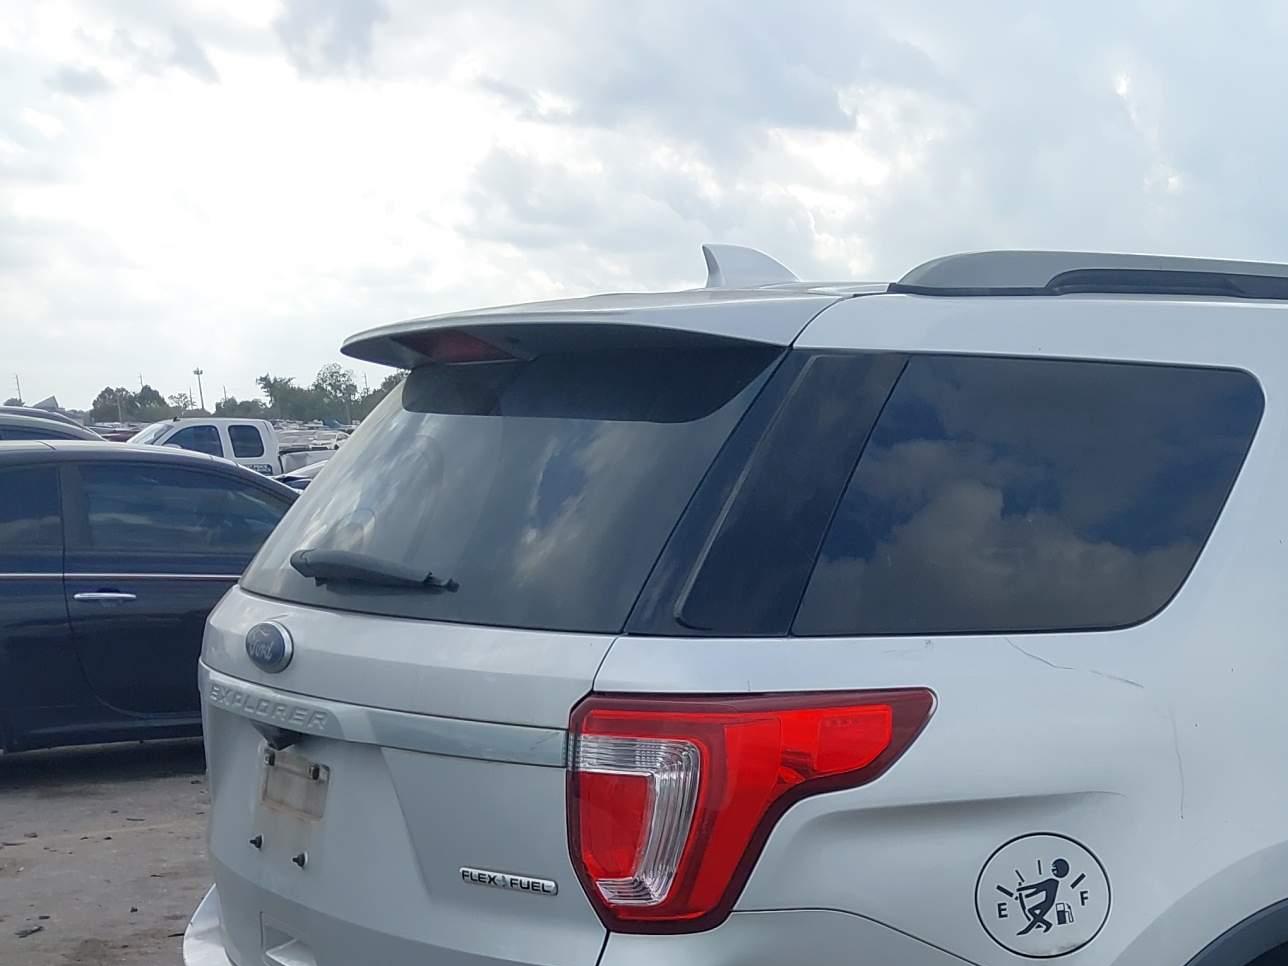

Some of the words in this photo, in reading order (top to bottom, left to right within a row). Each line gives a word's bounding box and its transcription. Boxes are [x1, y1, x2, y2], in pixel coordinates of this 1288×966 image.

[208, 684, 329, 729] EXPLORER
[461, 869, 498, 886] FLEX
[509, 877, 552, 893] FUEL
[1079, 890, 1089, 906] F
[997, 902, 1008, 919] E
